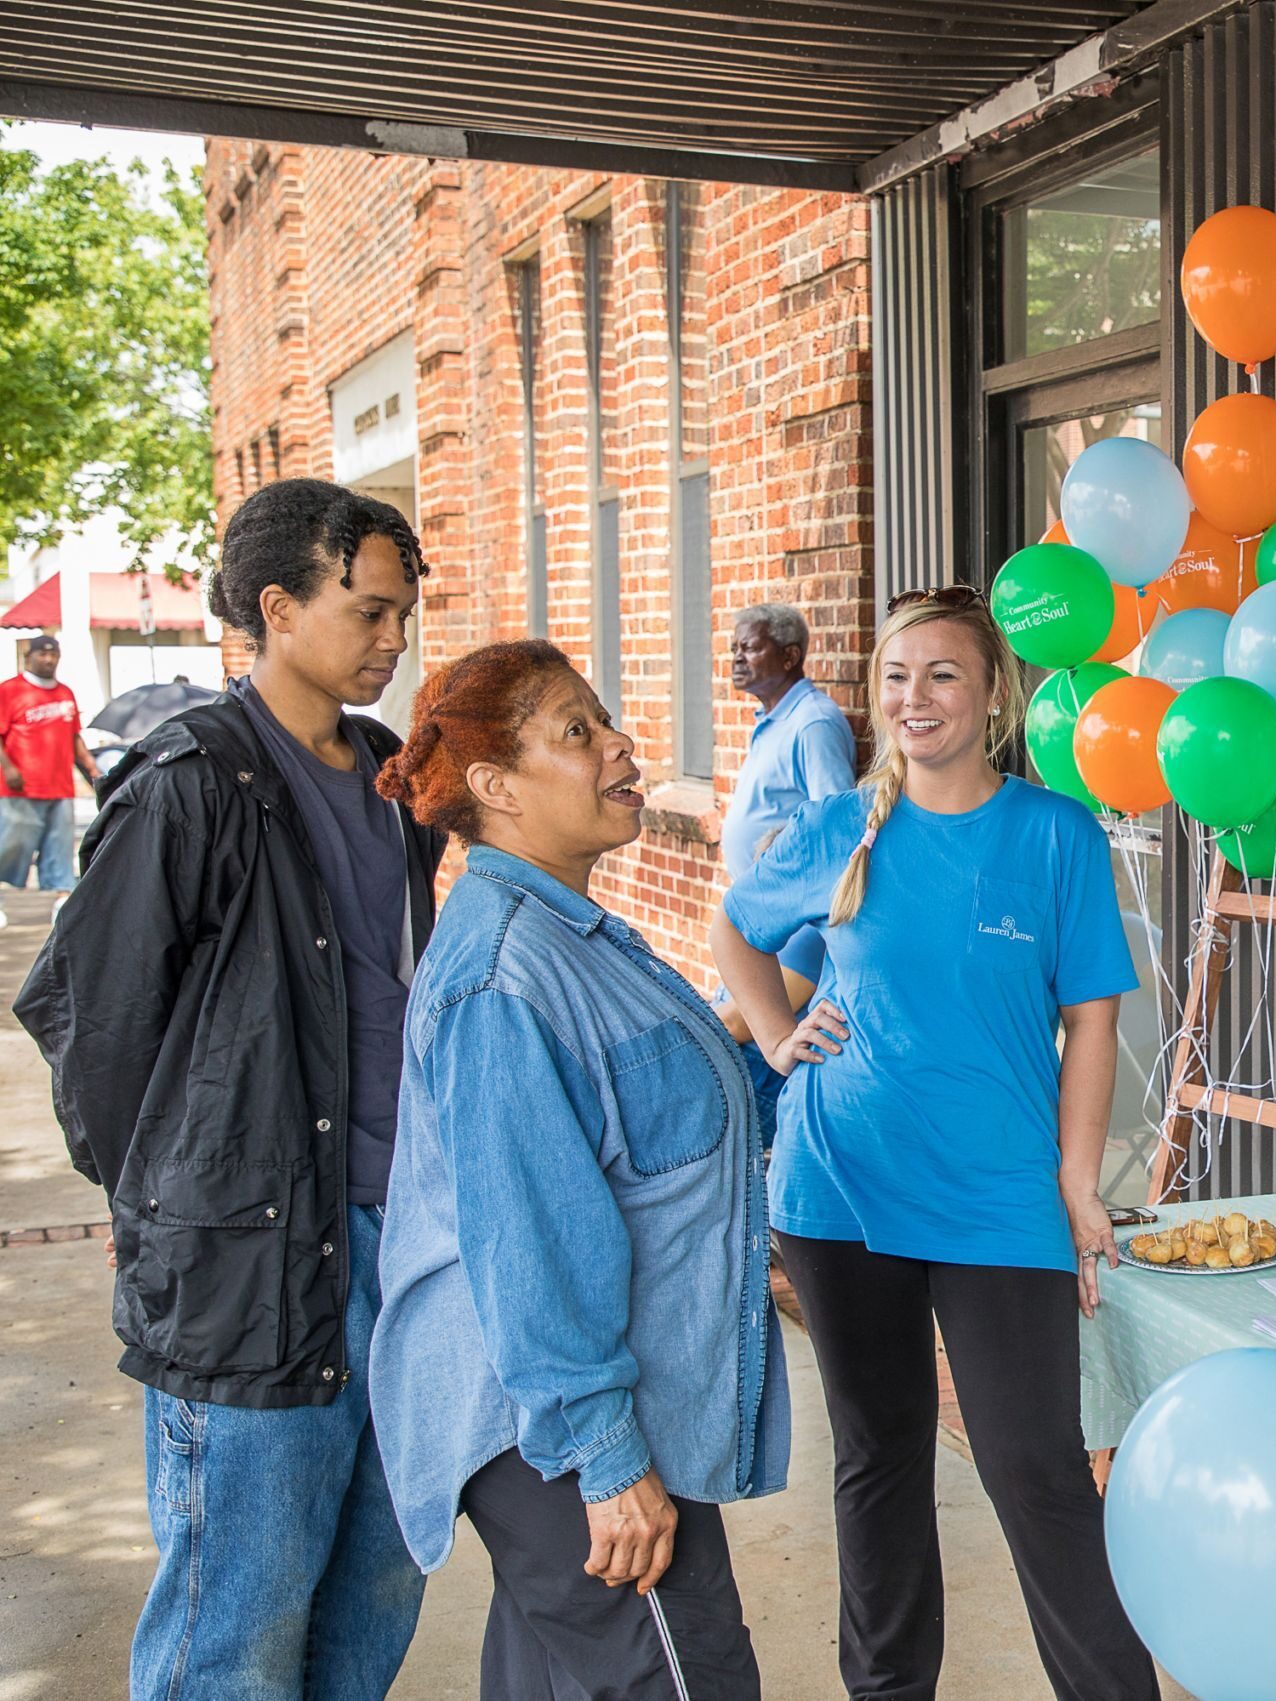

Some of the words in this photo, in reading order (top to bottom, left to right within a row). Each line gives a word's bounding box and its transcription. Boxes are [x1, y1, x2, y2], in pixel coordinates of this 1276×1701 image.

[1187, 556, 1214, 573] Soul
[1009, 595, 1049, 616] Community
[978, 922, 1010, 937] Lauren
[1009, 928, 1035, 943] James
